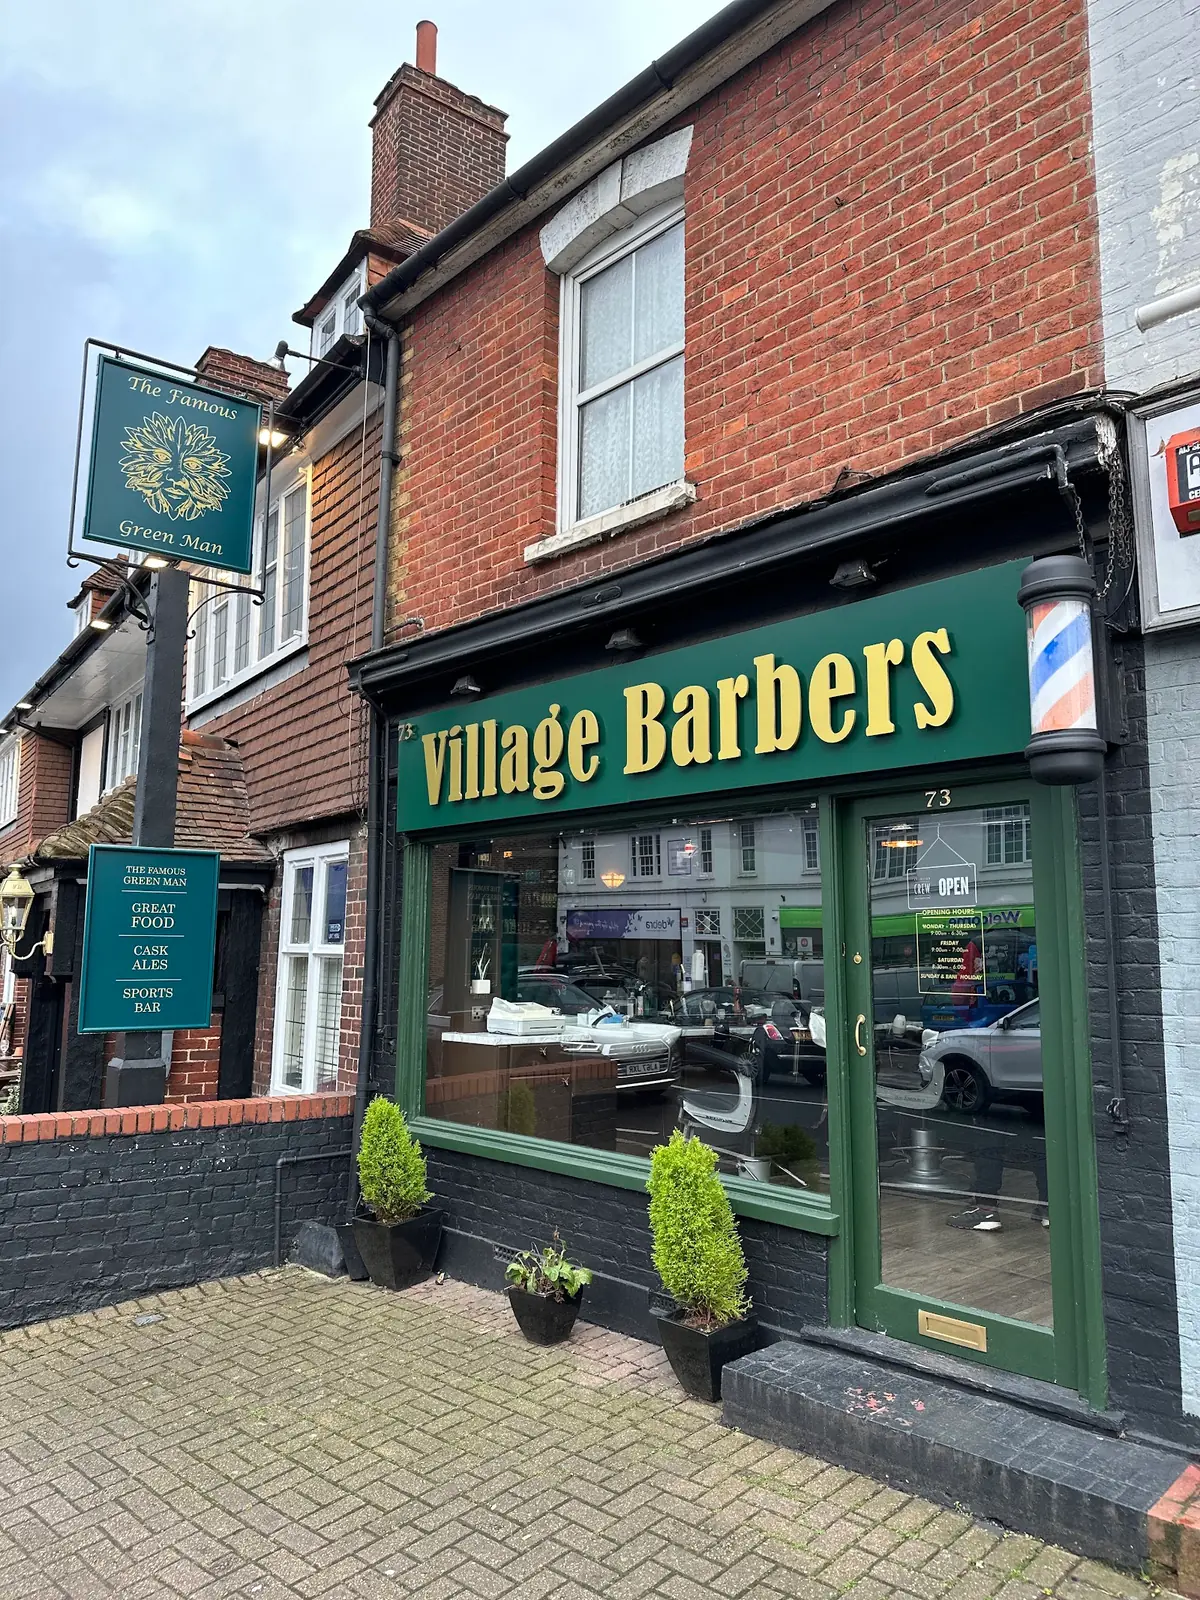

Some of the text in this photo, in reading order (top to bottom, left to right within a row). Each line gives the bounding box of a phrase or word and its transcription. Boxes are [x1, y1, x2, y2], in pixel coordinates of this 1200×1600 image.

[127, 376, 239, 420] The Famous
[119, 519, 224, 556] Green Man
[421, 627, 955, 806] Village Barbers
[397, 722, 414, 742] 73
[924, 788, 952, 808] 73
[125, 865, 186, 876] THE FAMOUS
[123, 876, 188, 887] GREEN MAN
[938, 876, 969, 897] OPEN
[914, 882, 931, 895] CREW
[131, 902, 176, 914] GREAT
[131, 916, 175, 929] FOOD
[133, 945, 169, 957] CASK
[132, 959, 169, 971] ALES
[122, 987, 174, 999] SPORTS
[134, 1002, 161, 1013] BAR
